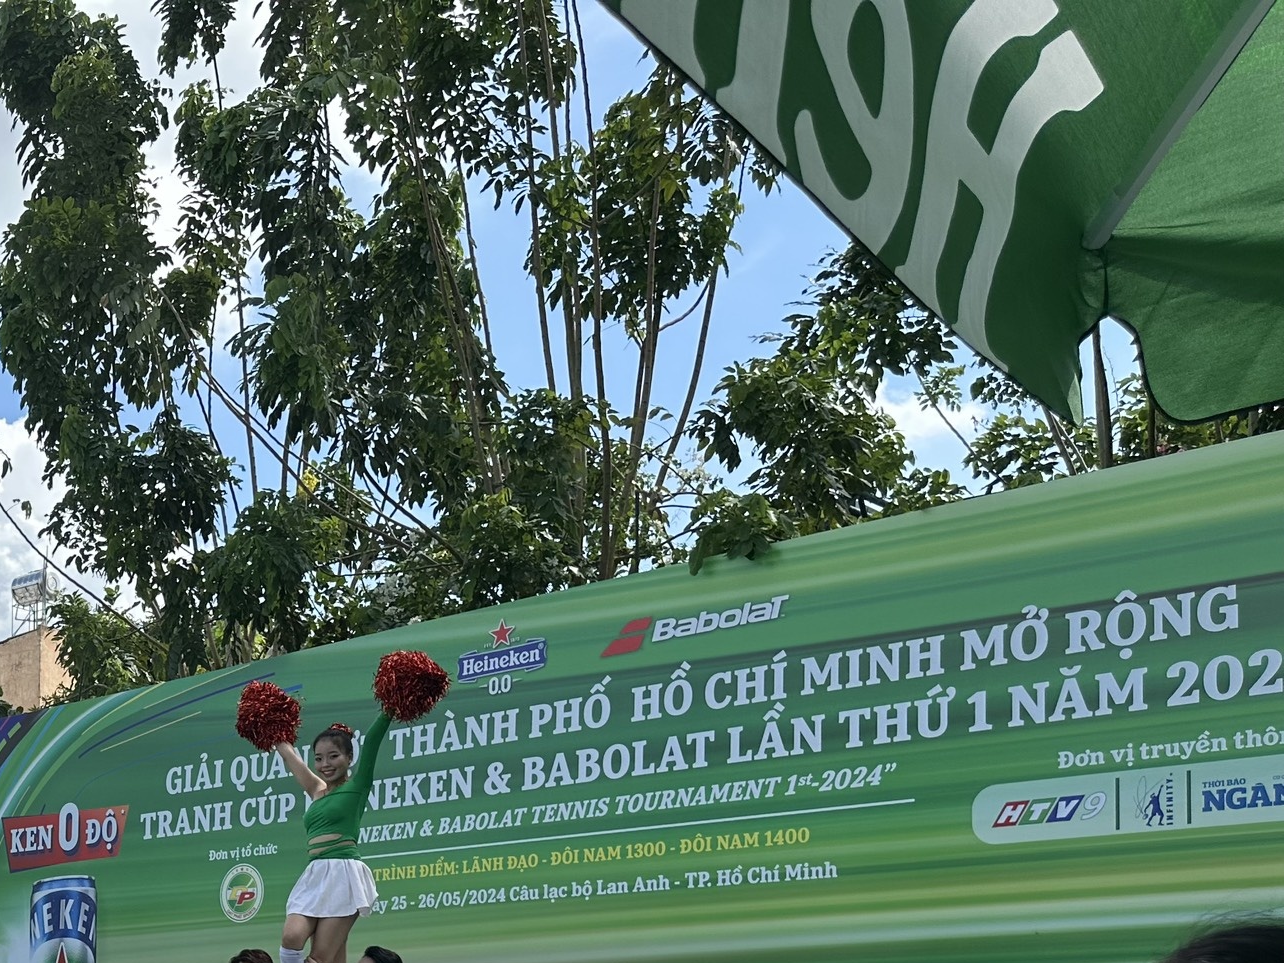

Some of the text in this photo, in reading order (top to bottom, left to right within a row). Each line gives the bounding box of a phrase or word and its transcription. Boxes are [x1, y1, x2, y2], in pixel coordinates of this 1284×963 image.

[462, 648, 541, 676] Heineken
[488, 674, 512, 695] 0.0
[166, 752, 224, 795] GIẢI
[389, 709, 519, 761] THÀNH
[528, 675, 612, 738] PHỐ
[630, 661, 694, 722] HỒ
[704, 649, 788, 710] CHÍ
[800, 634, 945, 696] MINH
[959, 604, 1049, 671] MỞ
[1065, 584, 1239, 660] RỘNG
[140, 800, 233, 841] TRANH
[239, 787, 296, 828] CÚP
[483, 761, 511, 796] &
[521, 730, 715, 790] BABOLAT
[727, 701, 826, 764] LẦN
[838, 684, 956, 749] THỨ
[966, 691, 993, 733] 1
[1007, 664, 1148, 728] NĂM
[1057, 750, 1105, 769] Đơn
[1110, 743, 1134, 767] vị
[1139, 730, 1228, 761] truyền
[10, 802, 117, 854] KEN 0 ĐỘ
[419, 819, 434, 837] &
[437, 808, 528, 835] BABOLAT
[531, 797, 610, 819] TENNIS
[614, 776, 781, 814] TOURNAMENT
[373, 864, 417, 882] TRÌNH
[419, 856, 459, 878] ĐIỂM:
[462, 853, 504, 875] LÃNH
[507, 853, 539, 873] ĐẠO
[550, 846, 579, 866] ĐÔI
[583, 845, 621, 863] NAM
[625, 841, 666, 858] 1300
[680, 833, 712, 854] ĐÔI
[716, 832, 760, 851] NAM
[764, 827, 810, 846] 1400
[391, 896, 407, 911] 25
[418, 887, 506, 909] 26/05/2024
[509, 885, 540, 902] Câu
[543, 884, 567, 903] lạc
[572, 880, 593, 901] bộ
[596, 880, 629, 896] Lan
[633, 875, 671, 893] Anh
[685, 871, 712, 888] TP.
[717, 864, 743, 886] Hồ
[747, 865, 780, 883] Chí
[784, 861, 838, 881] Minh
